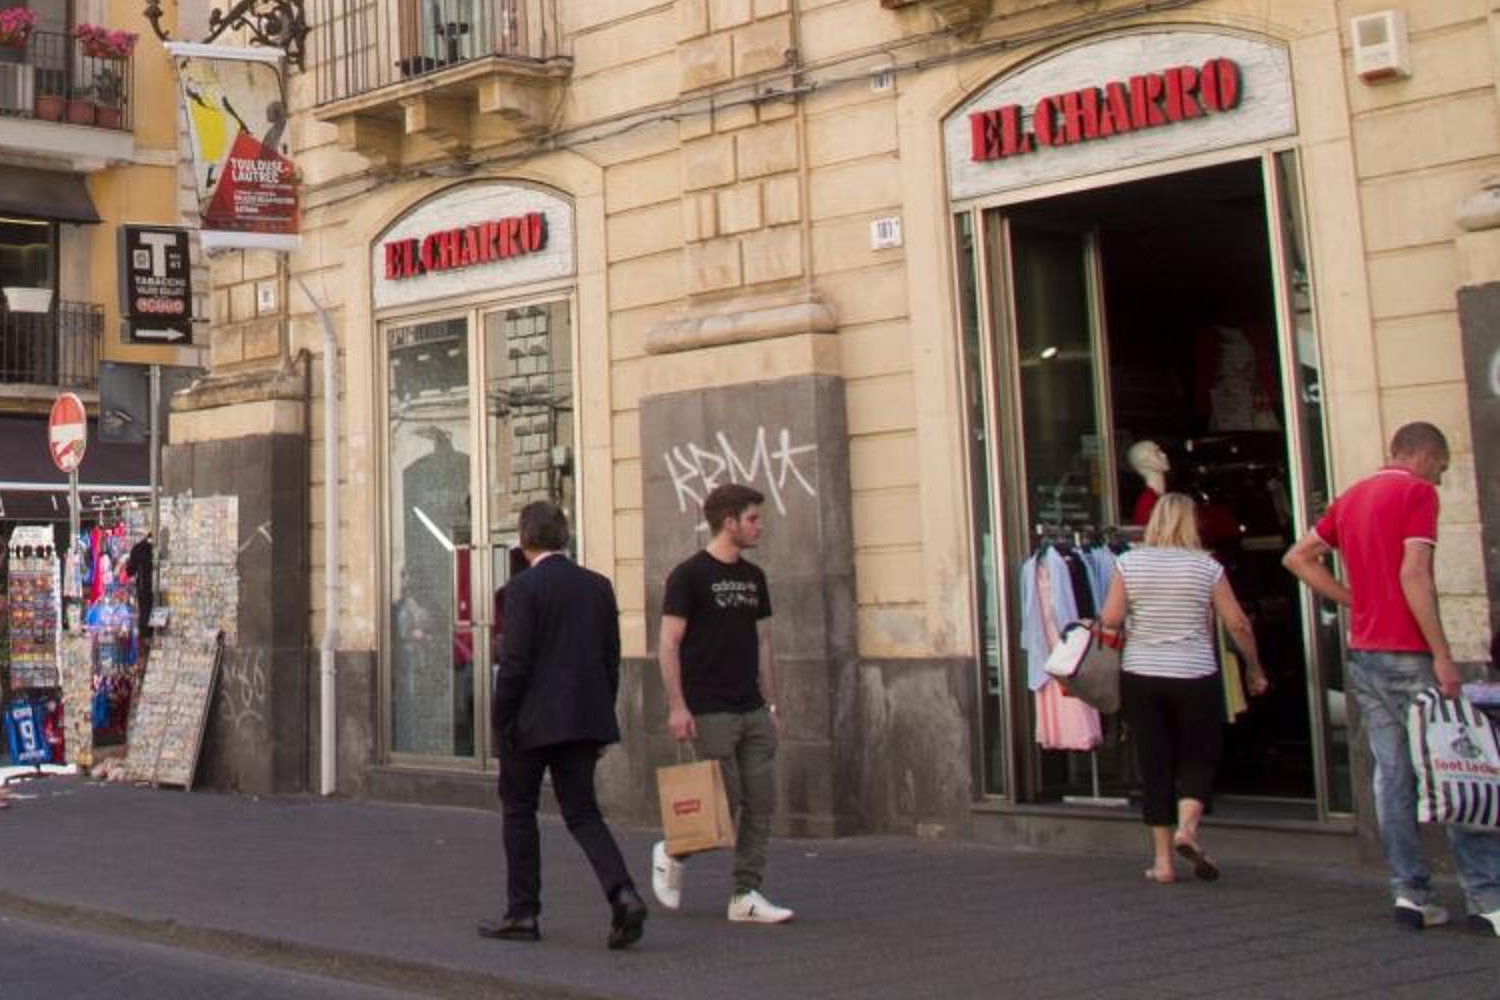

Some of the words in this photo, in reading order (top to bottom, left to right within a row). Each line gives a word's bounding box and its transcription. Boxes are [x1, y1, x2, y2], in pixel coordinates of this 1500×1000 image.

[969, 102, 1036, 162] EL
[1032, 56, 1243, 148] CHARRO
[139, 231, 177, 277] T
[384, 238, 423, 281] EL
[421, 211, 545, 271] CHARRO
[20, 720, 35, 751] 9
